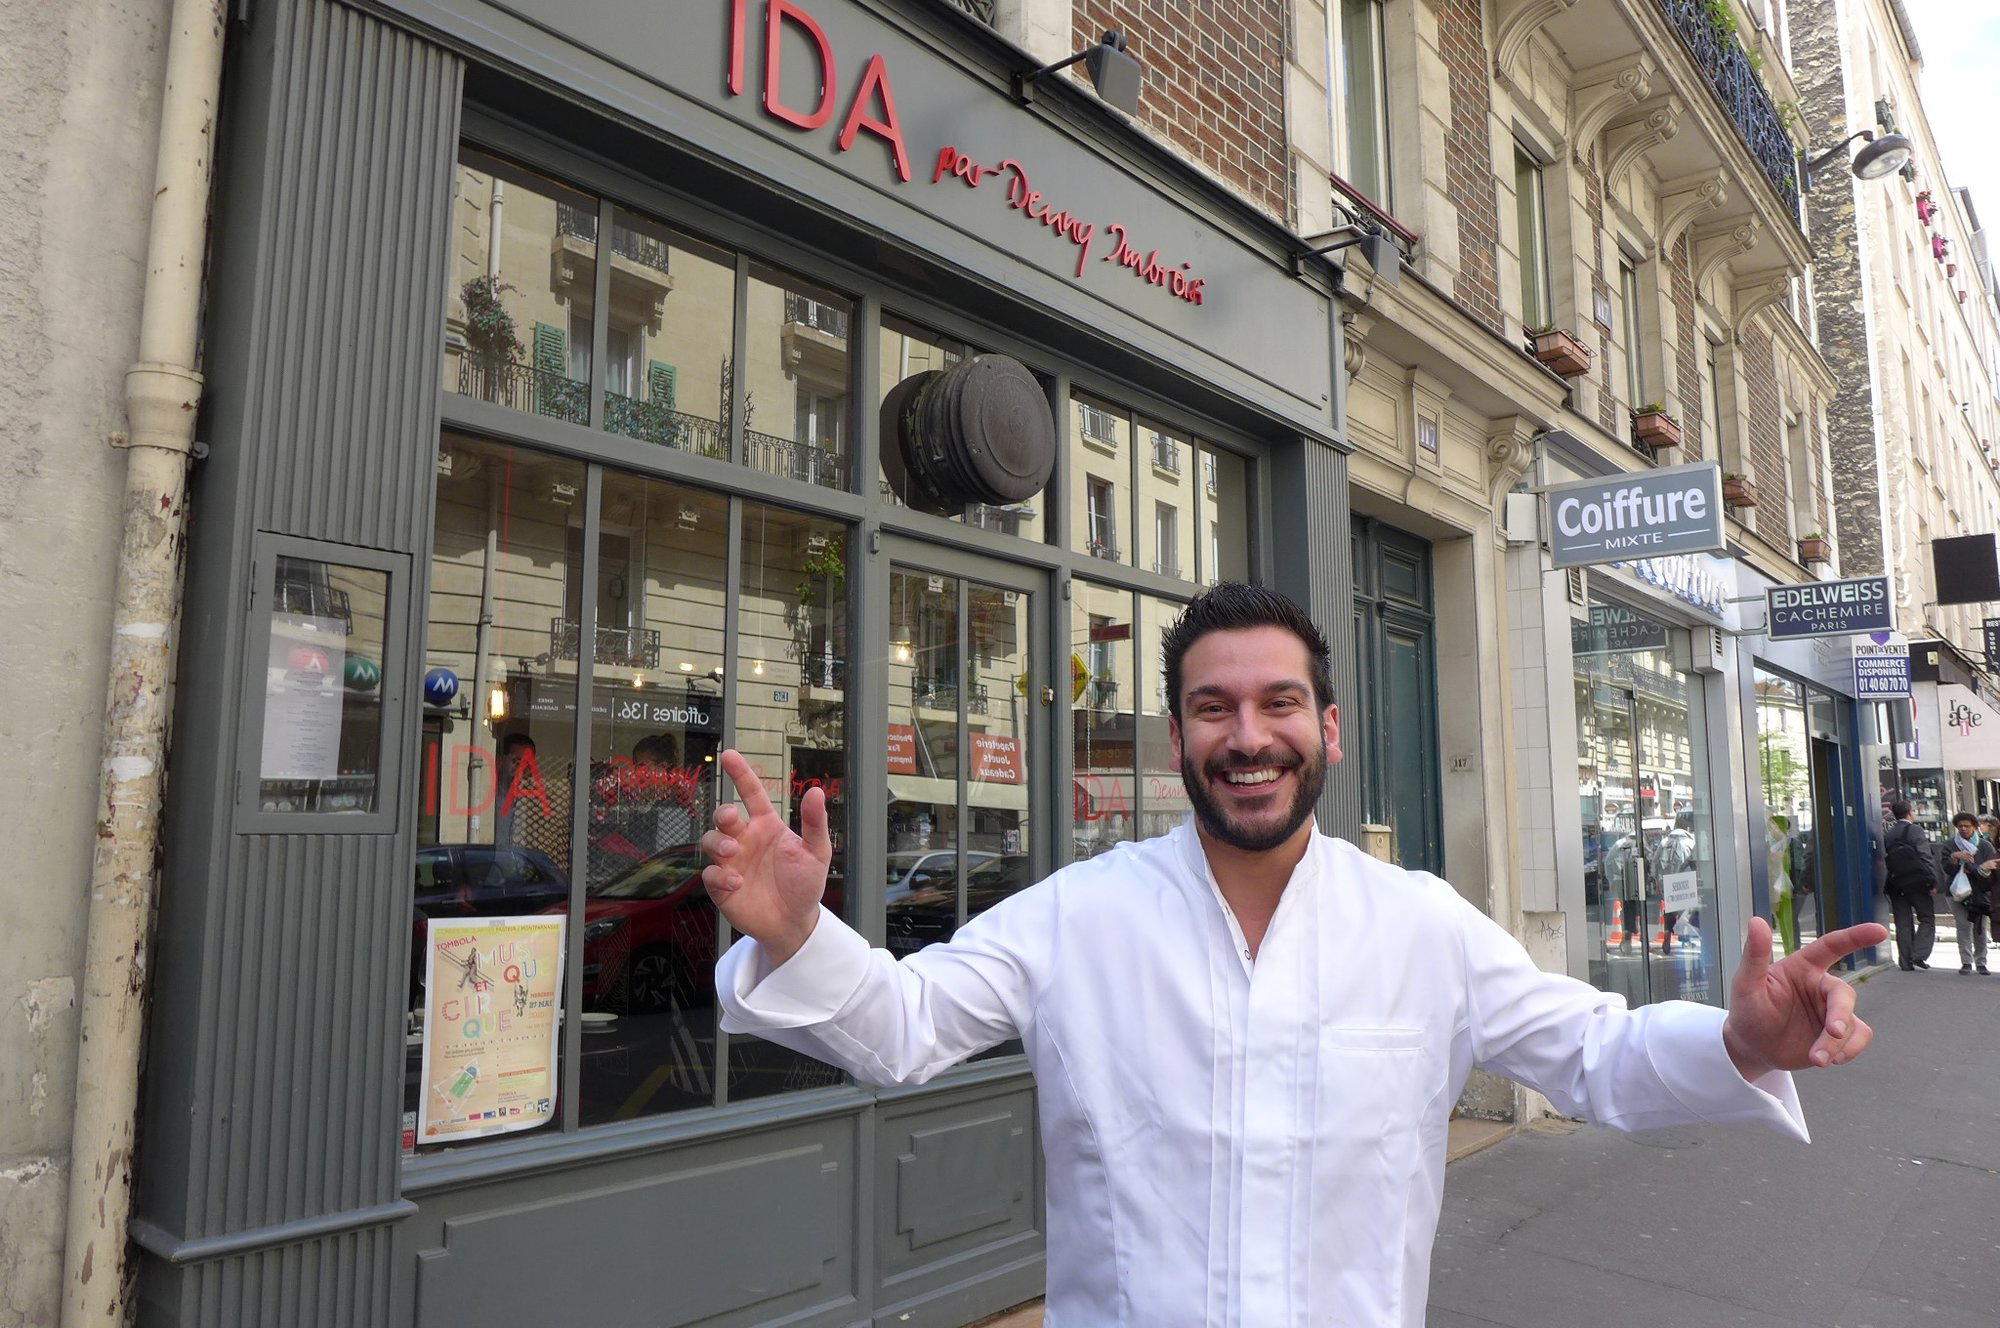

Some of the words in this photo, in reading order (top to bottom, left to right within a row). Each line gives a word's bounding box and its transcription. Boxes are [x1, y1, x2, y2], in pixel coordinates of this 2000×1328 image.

[728, 0, 911, 183] IDA
[933, 146, 1000, 188] par
[1420, 423, 1436, 448] 117
[1556, 486, 1707, 538] Coiffure
[1605, 532, 1663, 550] MIXTE
[1772, 581, 1884, 609] EDELWEISS
[1775, 603, 1884, 623] CACHEMIRE
[1811, 620, 1848, 632] PARIS
[1986, 620, 2000, 628] RES
[1856, 645, 1878, 654] POINT
[1885, 645, 1907, 654] VENTE
[1858, 659, 1906, 668] COMMERCE
[1858, 667, 1907, 676] DISPONIBLE
[1859, 678, 1868, 691] 01
[1869, 678, 1878, 691] 40
[1879, 678, 1888, 691] 60
[1889, 677, 1898, 690] 70
[1898, 677, 1908, 690] 70
[427, 742, 551, 818] IDA
[1074, 774, 1131, 822] IDA
[435, 935, 477, 952] TOMBOLA
[474, 981, 489, 992] ET
